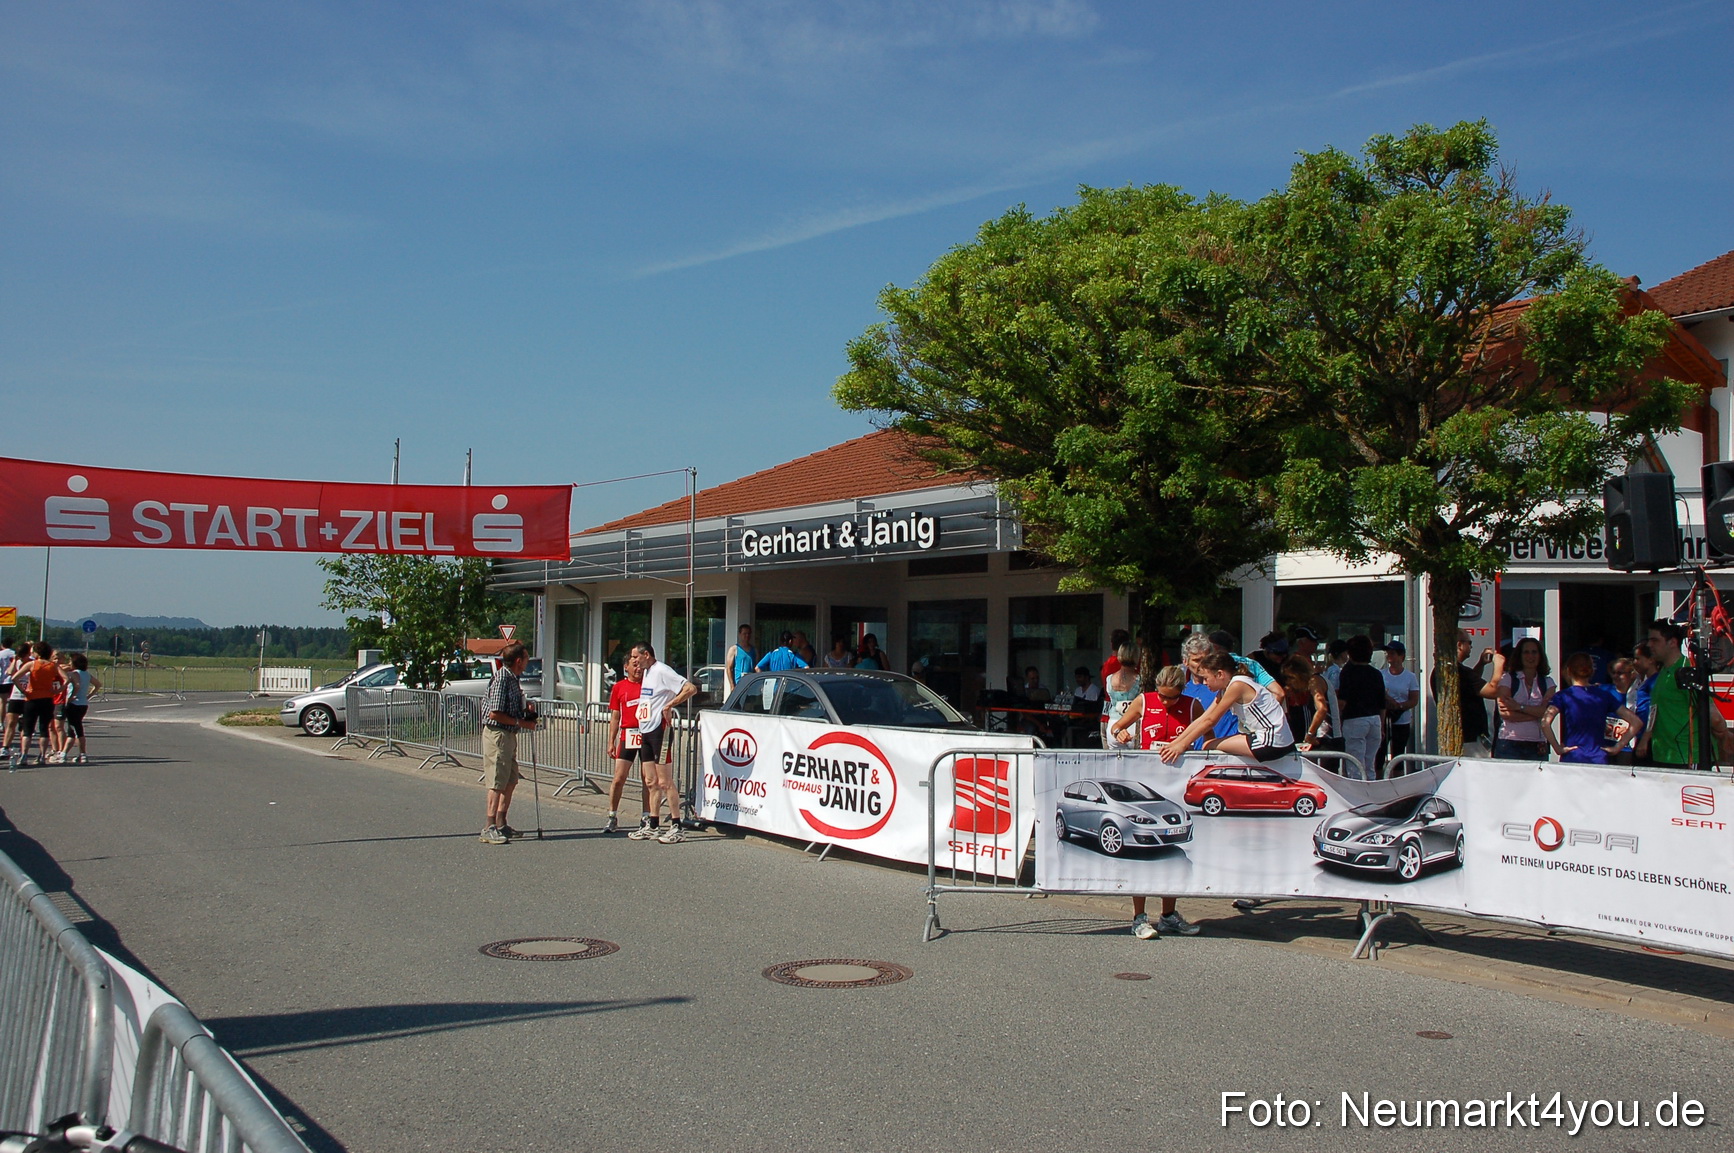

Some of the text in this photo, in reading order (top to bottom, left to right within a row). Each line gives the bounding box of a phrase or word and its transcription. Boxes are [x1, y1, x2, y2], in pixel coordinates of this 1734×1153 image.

[132, 501, 455, 552] START+ZIEL
[741, 511, 936, 557] Gerhart & Jänig
[1122, 701, 1132, 713] 2
[630, 733, 643, 746] 76
[726, 737, 752, 759] KIA
[782, 751, 880, 787] GERHART &
[724, 776, 767, 799] MOTORS
[710, 799, 732, 812] Power
[819, 784, 882, 816] JÄNIG
[1500, 816, 1639, 854] COPA
[1670, 817, 1727, 831] SEAT
[947, 840, 1012, 861] SEAT
[1501, 854, 1732, 895] MIT EINEM UPGRADE IST DAS LEBEN SCHÖNER.
[1597, 913, 1612, 922] EINE
[1614, 916, 1637, 926] MARKE
[1638, 920, 1652, 928] DER
[1654, 922, 1703, 937] VOLKSWAGEN
